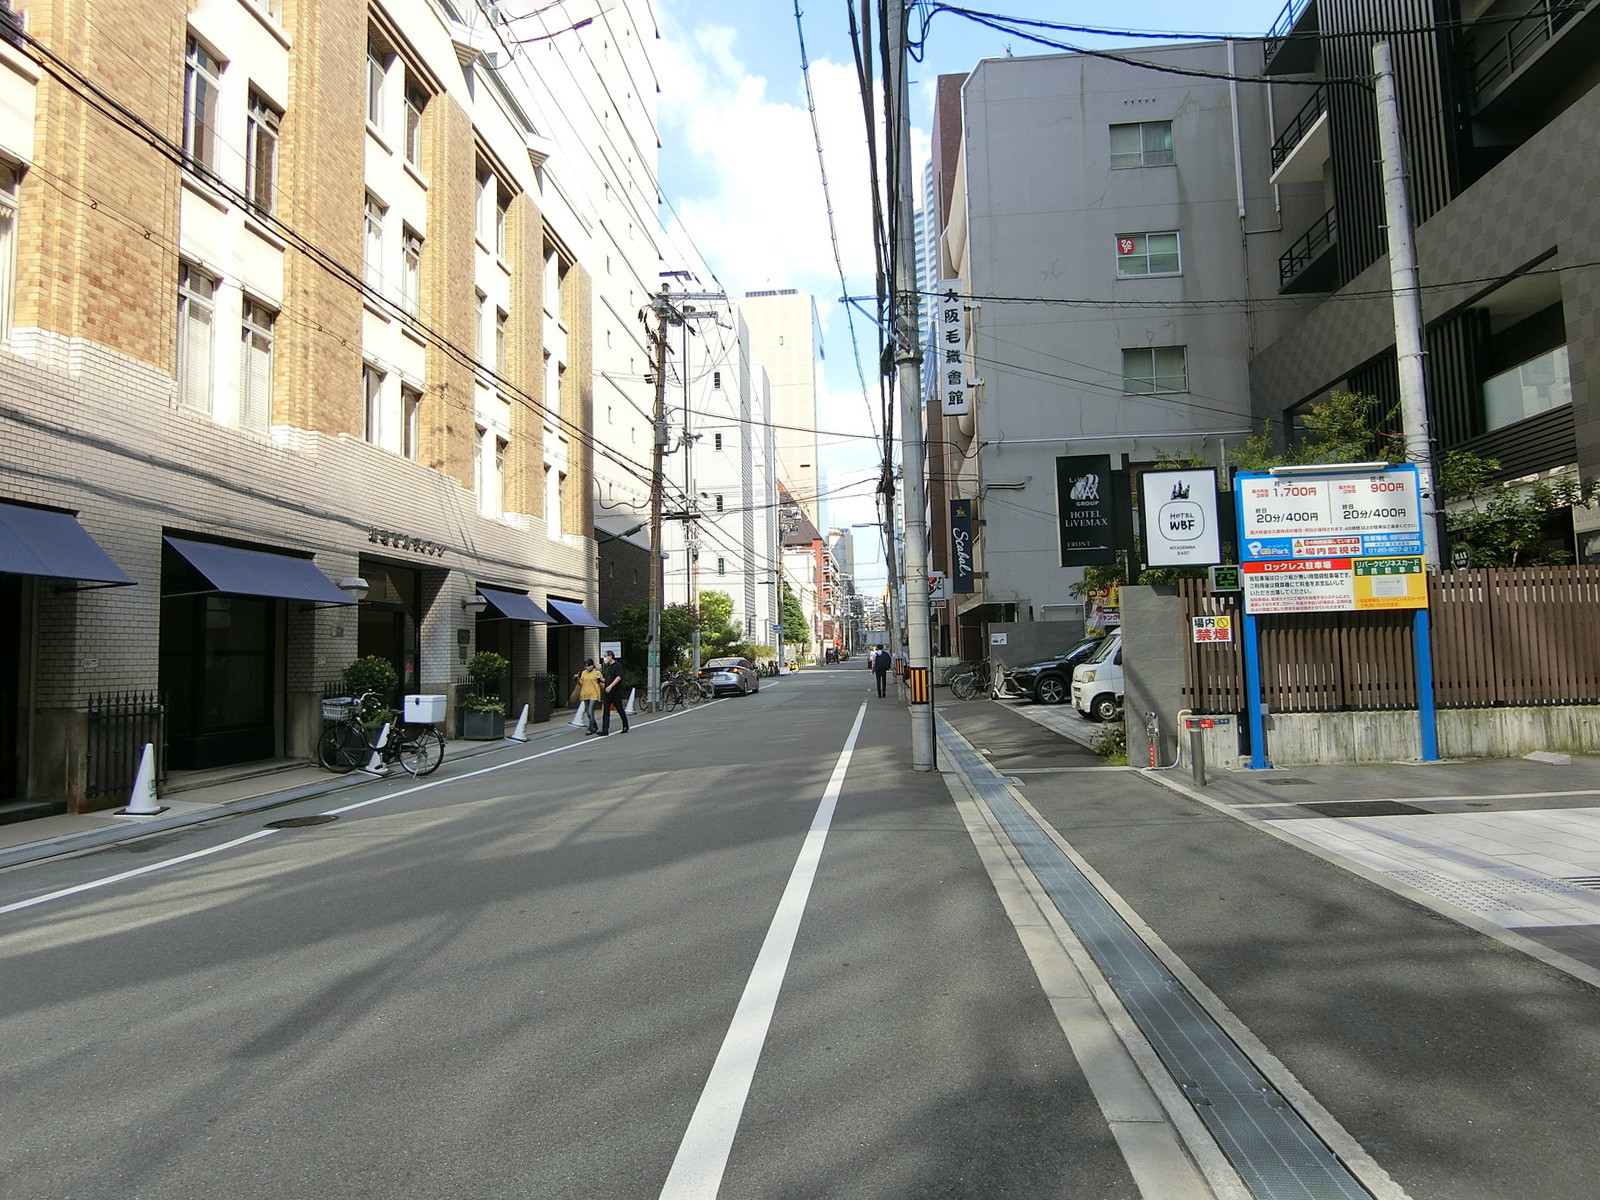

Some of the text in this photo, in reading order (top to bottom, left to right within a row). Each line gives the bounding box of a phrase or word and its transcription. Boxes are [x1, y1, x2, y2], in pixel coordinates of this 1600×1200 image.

[1273, 487, 1317, 498] 1,700円
[1370, 482, 1404, 493] 900円
[1070, 510, 1102, 519] HOTEL
[1170, 512, 1194, 520] HOTEL
[1256, 512, 1319, 524] 20分/400円
[1343, 508, 1406, 520] 20分/400円
[1169, 519, 1195, 531] WBF
[1305, 546, 1360, 555] 場内監視中
[1264, 561, 1332, 571] ロックレス駐車場
[1356, 559, 1420, 568] リパークビジネスカード
[1194, 618, 1215, 628] 場内
[1196, 628, 1229, 641] 禁煙
